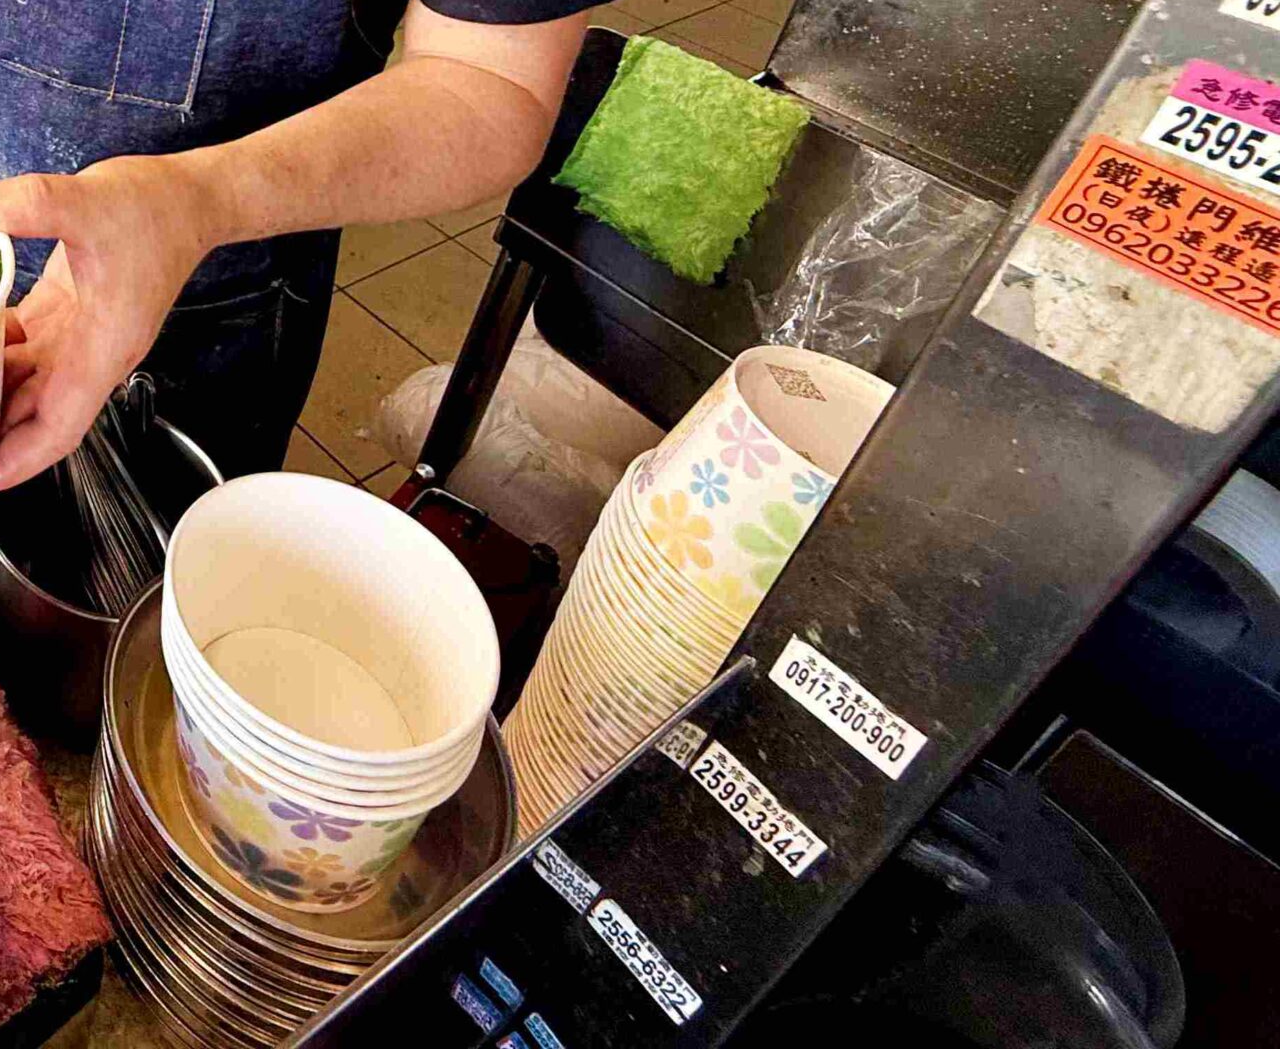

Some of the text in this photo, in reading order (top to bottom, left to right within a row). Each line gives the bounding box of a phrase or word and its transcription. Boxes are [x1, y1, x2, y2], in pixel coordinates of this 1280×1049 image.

[786, 661, 905, 762] 0917-200-900
[694, 759, 806, 868] 2599-3344
[598, 909, 687, 1008] 2556-6322
